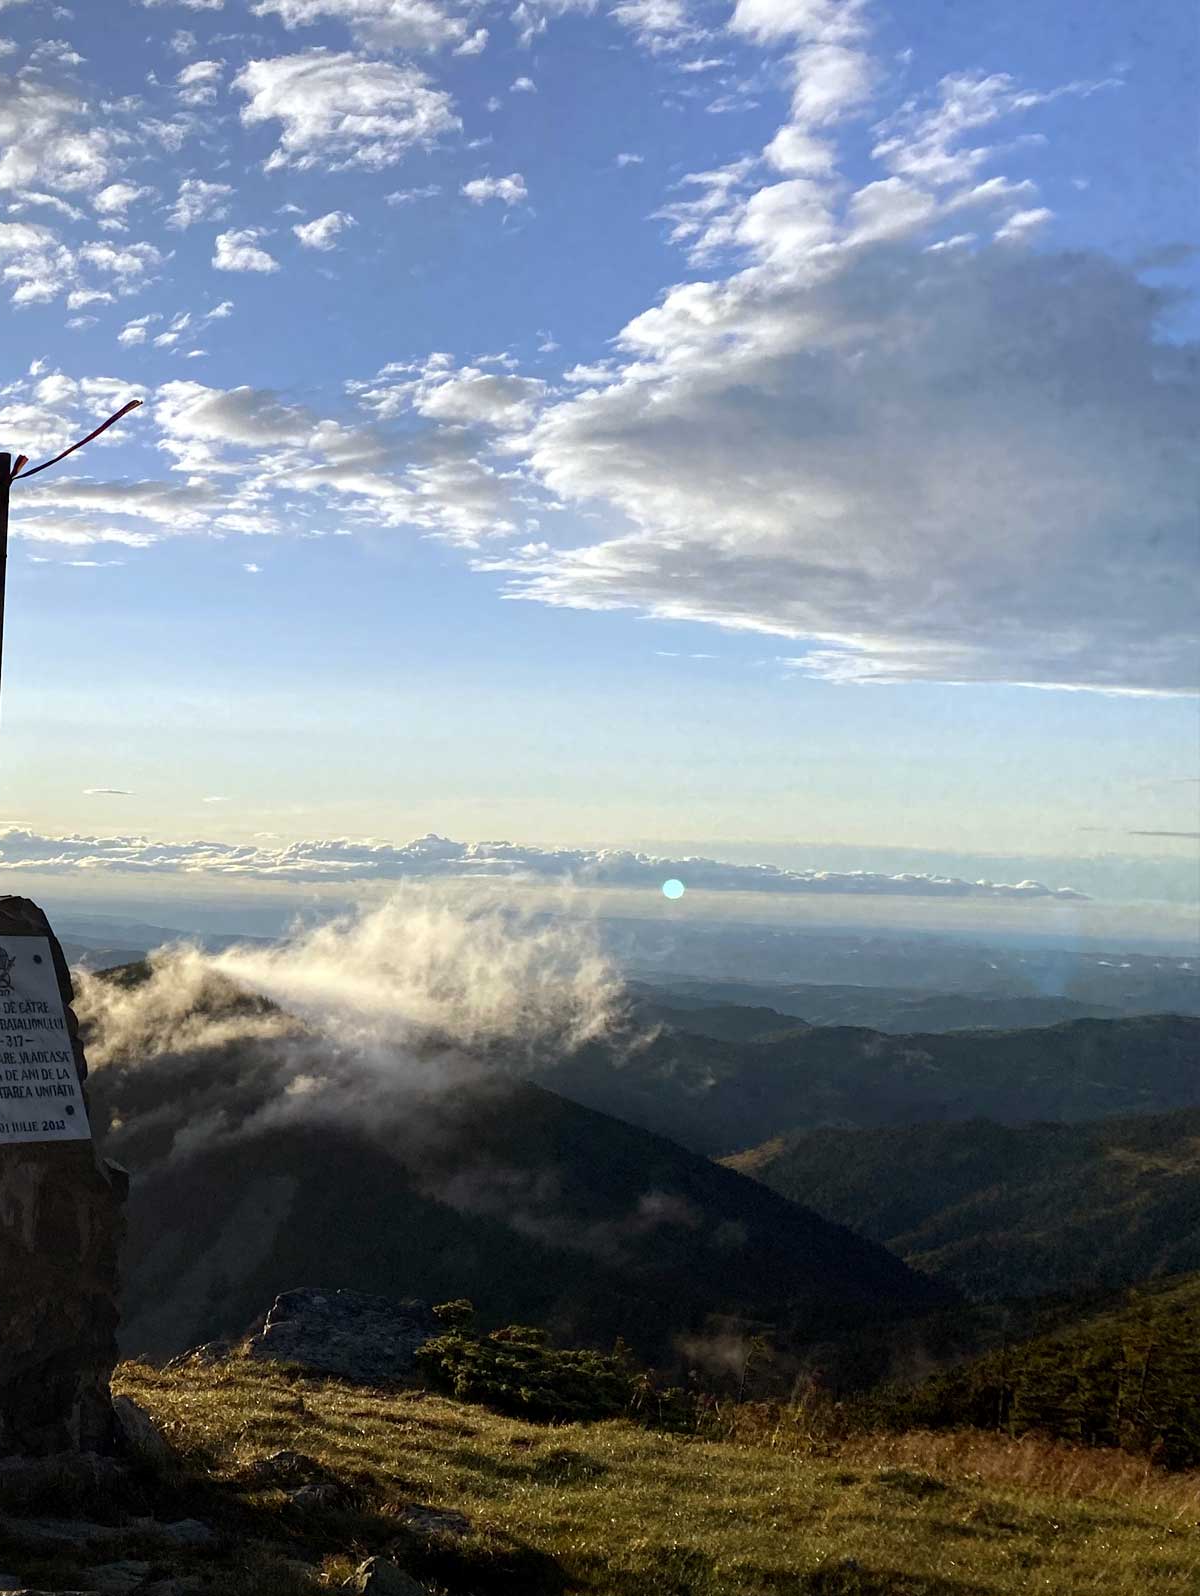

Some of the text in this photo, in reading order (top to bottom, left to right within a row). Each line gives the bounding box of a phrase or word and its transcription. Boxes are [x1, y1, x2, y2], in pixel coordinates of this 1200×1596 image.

[3, 1001, 17, 1014] DE
[0, 1017, 64, 1031] BATALIONULUI
[5, 1069, 19, 1081] DE
[21, 1069, 39, 1081] ANI
[41, 1068, 55, 1080] DE
[56, 1068, 70, 1080] LA
[12, 1121, 39, 1133] IULIE
